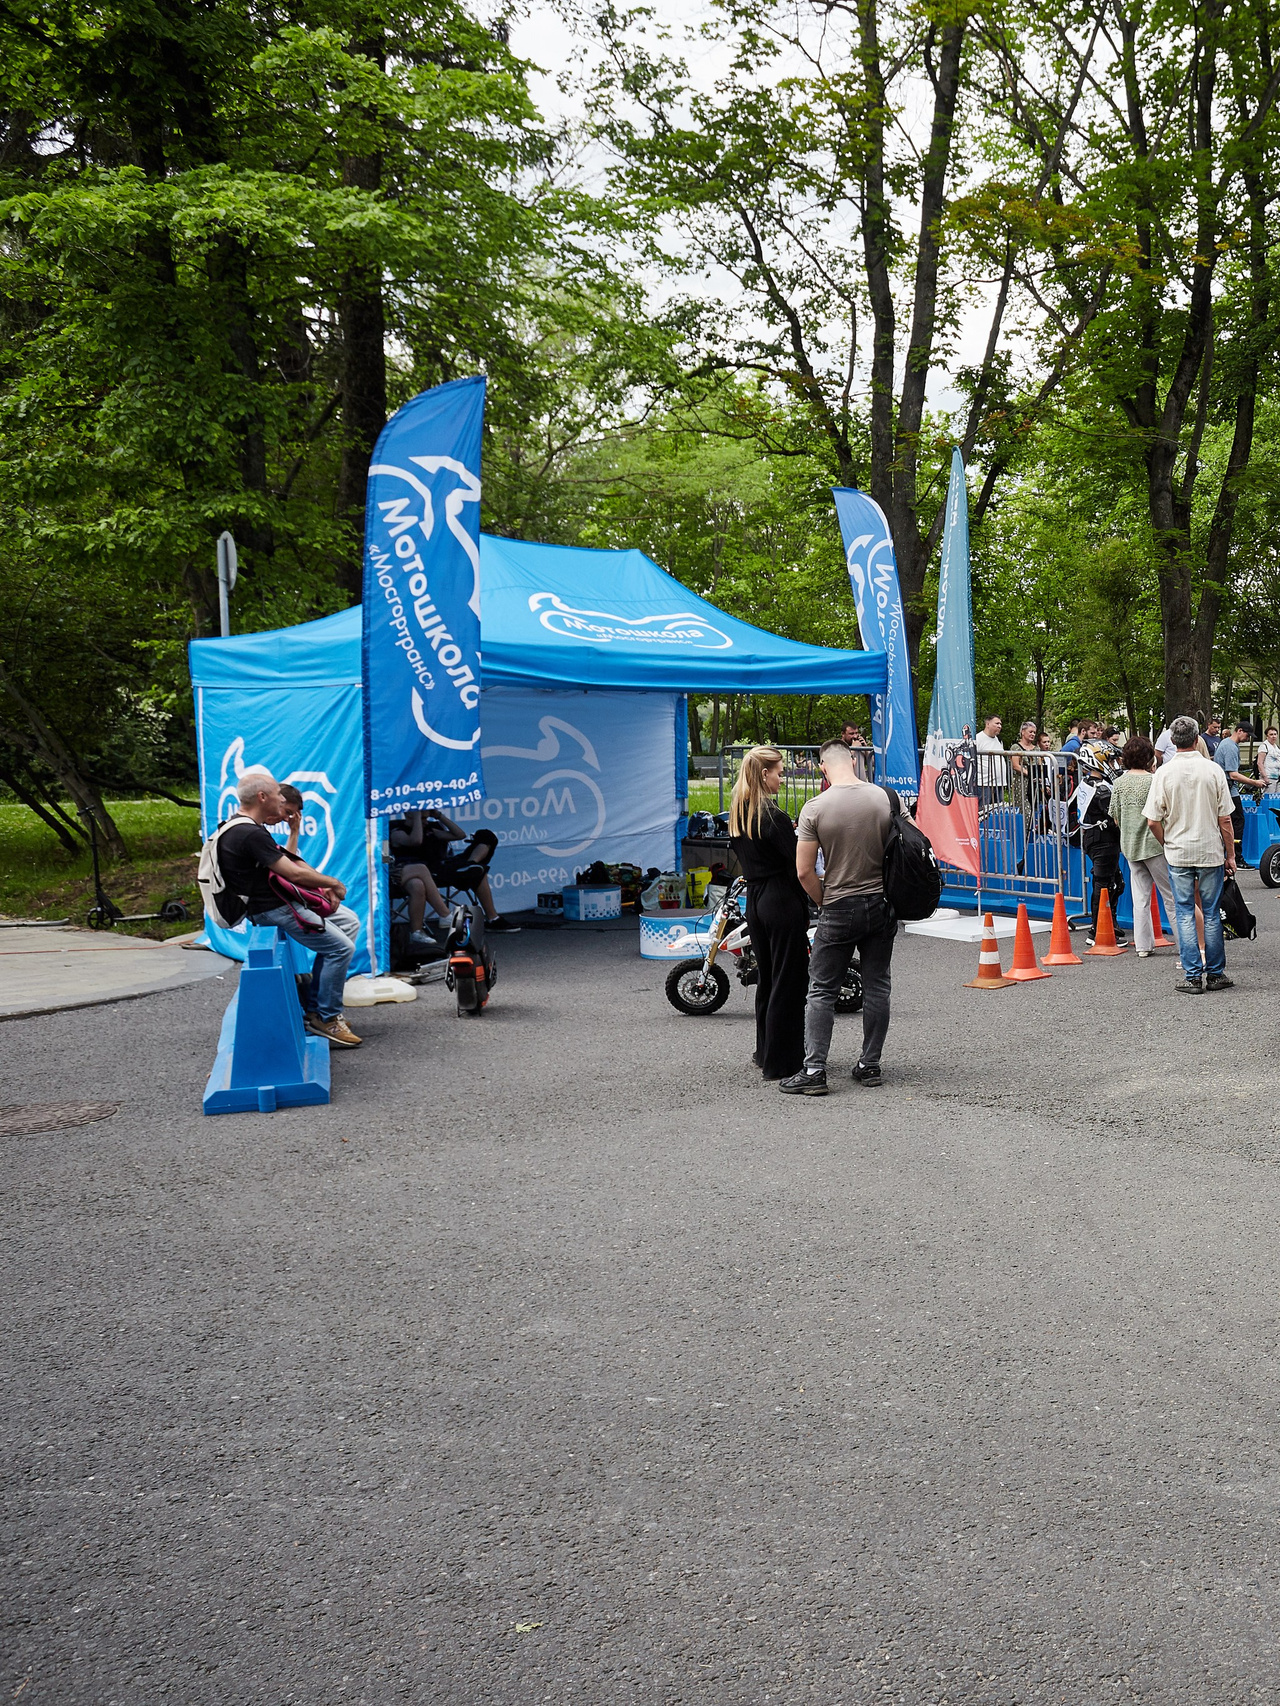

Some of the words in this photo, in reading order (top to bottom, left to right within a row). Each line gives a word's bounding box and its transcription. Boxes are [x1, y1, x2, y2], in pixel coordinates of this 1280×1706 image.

[368, 543, 435, 691] «Мосгортранс»
[377, 497, 481, 710] Мотошкола
[562, 617, 705, 640] Мотошкола
[595, 632, 694, 646] «Мосгортранс»
